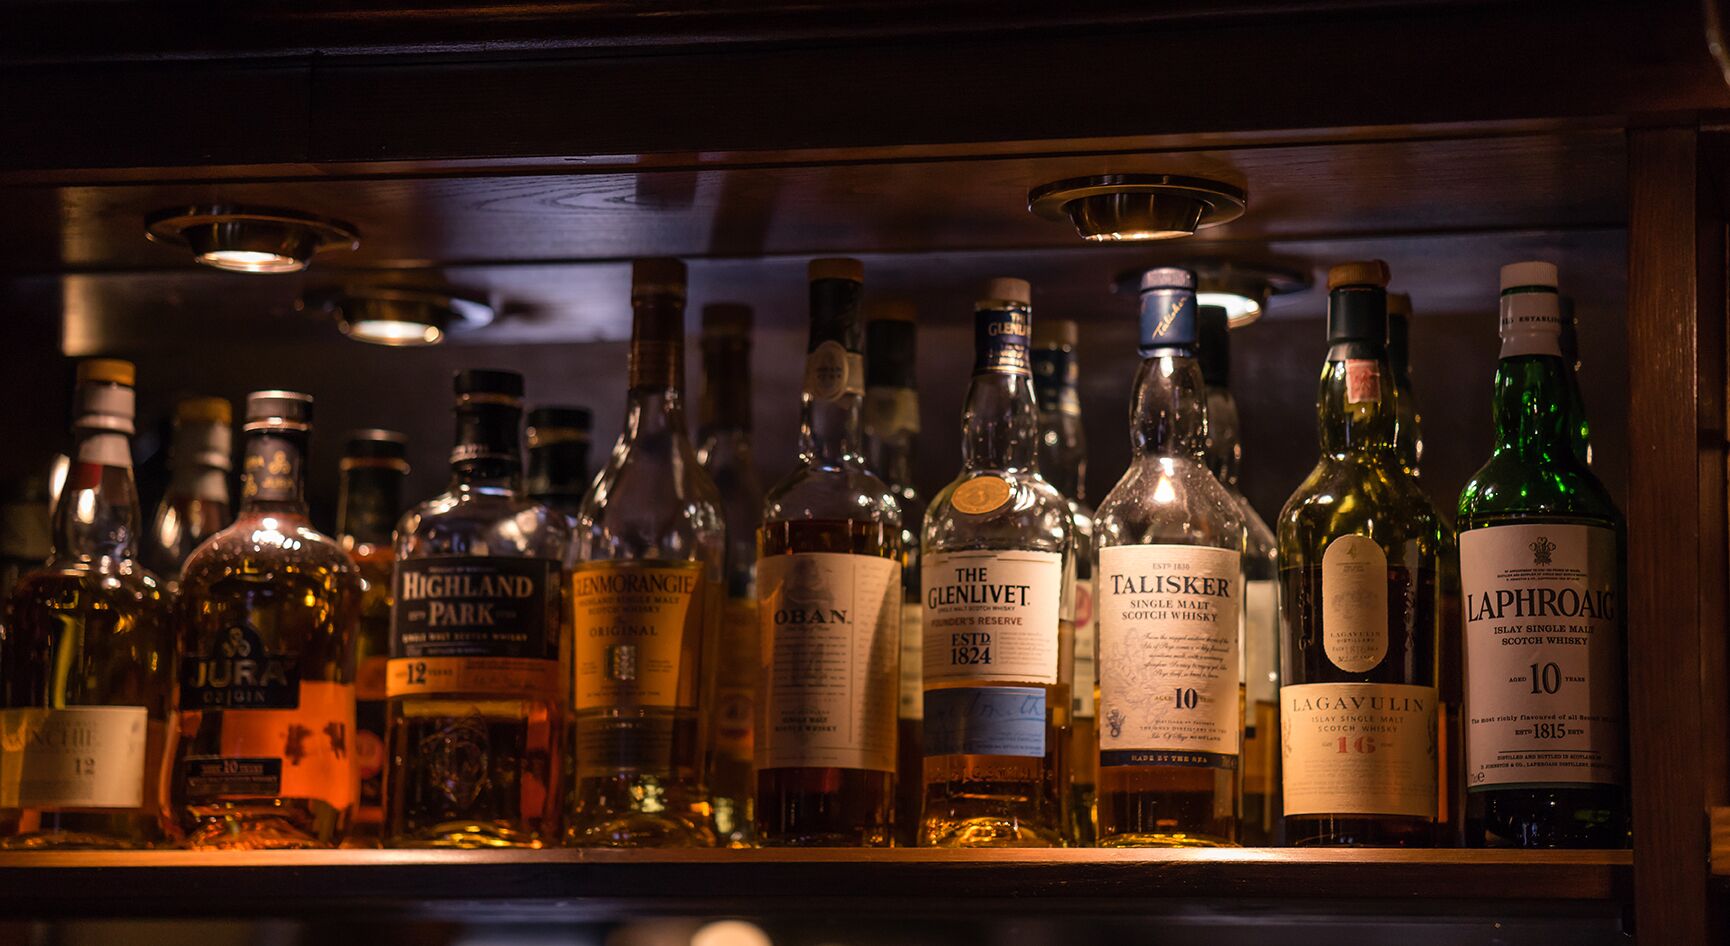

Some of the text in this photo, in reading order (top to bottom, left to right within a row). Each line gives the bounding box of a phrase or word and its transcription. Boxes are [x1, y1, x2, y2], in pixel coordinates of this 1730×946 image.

[955, 567, 987, 583] THE
[402, 571, 535, 600] HIGHLAND
[1110, 574, 1231, 598] TALISKER
[1131, 600, 1211, 610] SINGLE MALT
[1467, 588, 1614, 622] LAPHROAIG
[428, 601, 496, 627] PARK
[978, 616, 1023, 626] RESERVE
[1122, 611, 1218, 622] SCOTCH WHISKY
[590, 625, 659, 638] ORIGINAL
[1494, 626, 1522, 634] ISLAY
[1526, 624, 1566, 632] SINGLE
[1502, 637, 1588, 645] SCOTCH WHISKY
[951, 647, 992, 665] 1824
[191, 658, 288, 688] JURA
[407, 662, 426, 685] 12
[1530, 662, 1561, 695] 10
[1174, 688, 1198, 710] 10
[1293, 697, 1424, 712] LAGAVULIN
[1341, 715, 1373, 723] SINGLE
[1380, 715, 1405, 724] MALT
[1497, 716, 1517, 724] richly
[1318, 725, 1398, 733] SCOTCH WHISKY
[1533, 723, 1566, 739] 1815
[1337, 736, 1376, 754] 16
[76, 758, 95, 775] 12
[223, 759, 239, 775] 10
